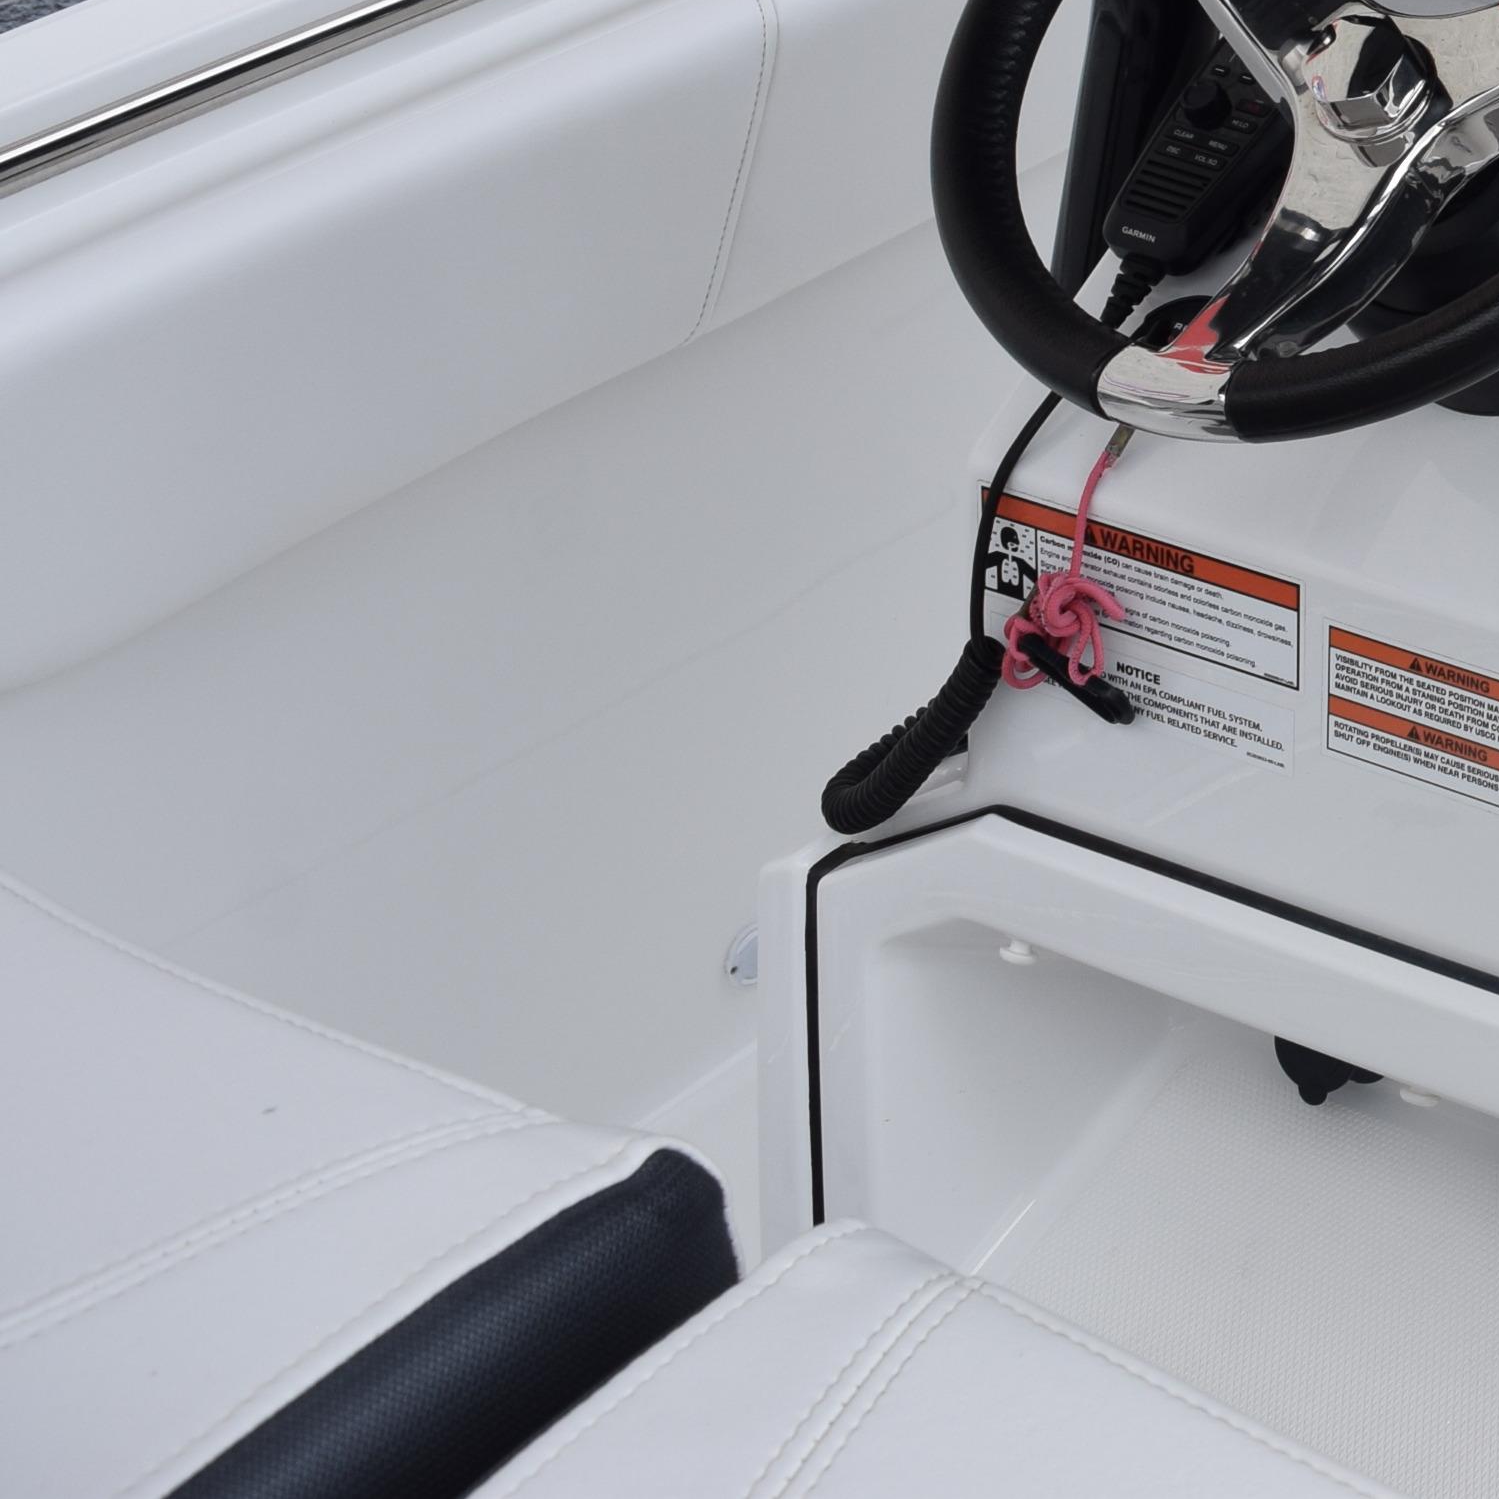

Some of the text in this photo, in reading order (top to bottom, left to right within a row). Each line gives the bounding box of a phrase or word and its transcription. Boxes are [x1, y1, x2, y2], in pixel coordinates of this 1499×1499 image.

[1122, 225, 1156, 243] GARMIN
[1100, 528, 1195, 575] WARNING
[1104, 555, 1120, 567] (CO)
[1116, 661, 1161, 685] NOTICE
[1335, 653, 1373, 672] VISIBILITY
[1375, 667, 1397, 679] FROM
[1399, 674, 1414, 685] THE
[1416, 680, 1446, 696] SEATED
[1449, 690, 1485, 709] POSITION
[1335, 663, 1378, 683] OPERATION
[1381, 678, 1403, 691] FROM
[1448, 700, 1484, 718] POSITION
[1425, 661, 1490, 693] WARNING
[1108, 673, 1263, 732] WITH AN EPA COMPLIANT FUEL SYSTEM.
[1126, 691, 1285, 752] THE COMPONENTS THAT ARE INSTALLED.
[1335, 673, 1358, 686] AVOID
[1360, 680, 1394, 698] SERIOUS
[1395, 691, 1423, 706] INJURY
[1425, 700, 1436, 711] OR
[1438, 705, 1464, 721] DEATH
[1466, 715, 1489, 729] FROM
[1335, 682, 1368, 699] MAINTAIN
[1376, 695, 1411, 713] LOOKOUT
[1412, 707, 1423, 717] AS
[1424, 710, 1461, 729] REQUIRED
[1463, 724, 1474, 733] BY
[1475, 727, 1496, 741] USCG
[1146, 710, 1166, 724] FUEL
[1168, 717, 1201, 735] RELATED
[1203, 729, 1238, 748] SERVICE.
[1334, 720, 1369, 739] ROTATING
[1371, 732, 1422, 757] PROPELLER(S)
[1423, 750, 1439, 762] MAY
[1440, 756, 1466, 771] CAUSE
[1467, 765, 1499, 783] SERIOUS
[1423, 730, 1488, 762] WARNING
[1334, 729, 1354, 742] SHUT
[1355, 737, 1371, 748] OFF
[1372, 742, 1411, 762] ENGINE(S)
[1412, 756, 1436, 770] WHEN
[1438, 764, 1460, 778] NEAR
[1461, 772, 1499, 792] PERSONS
